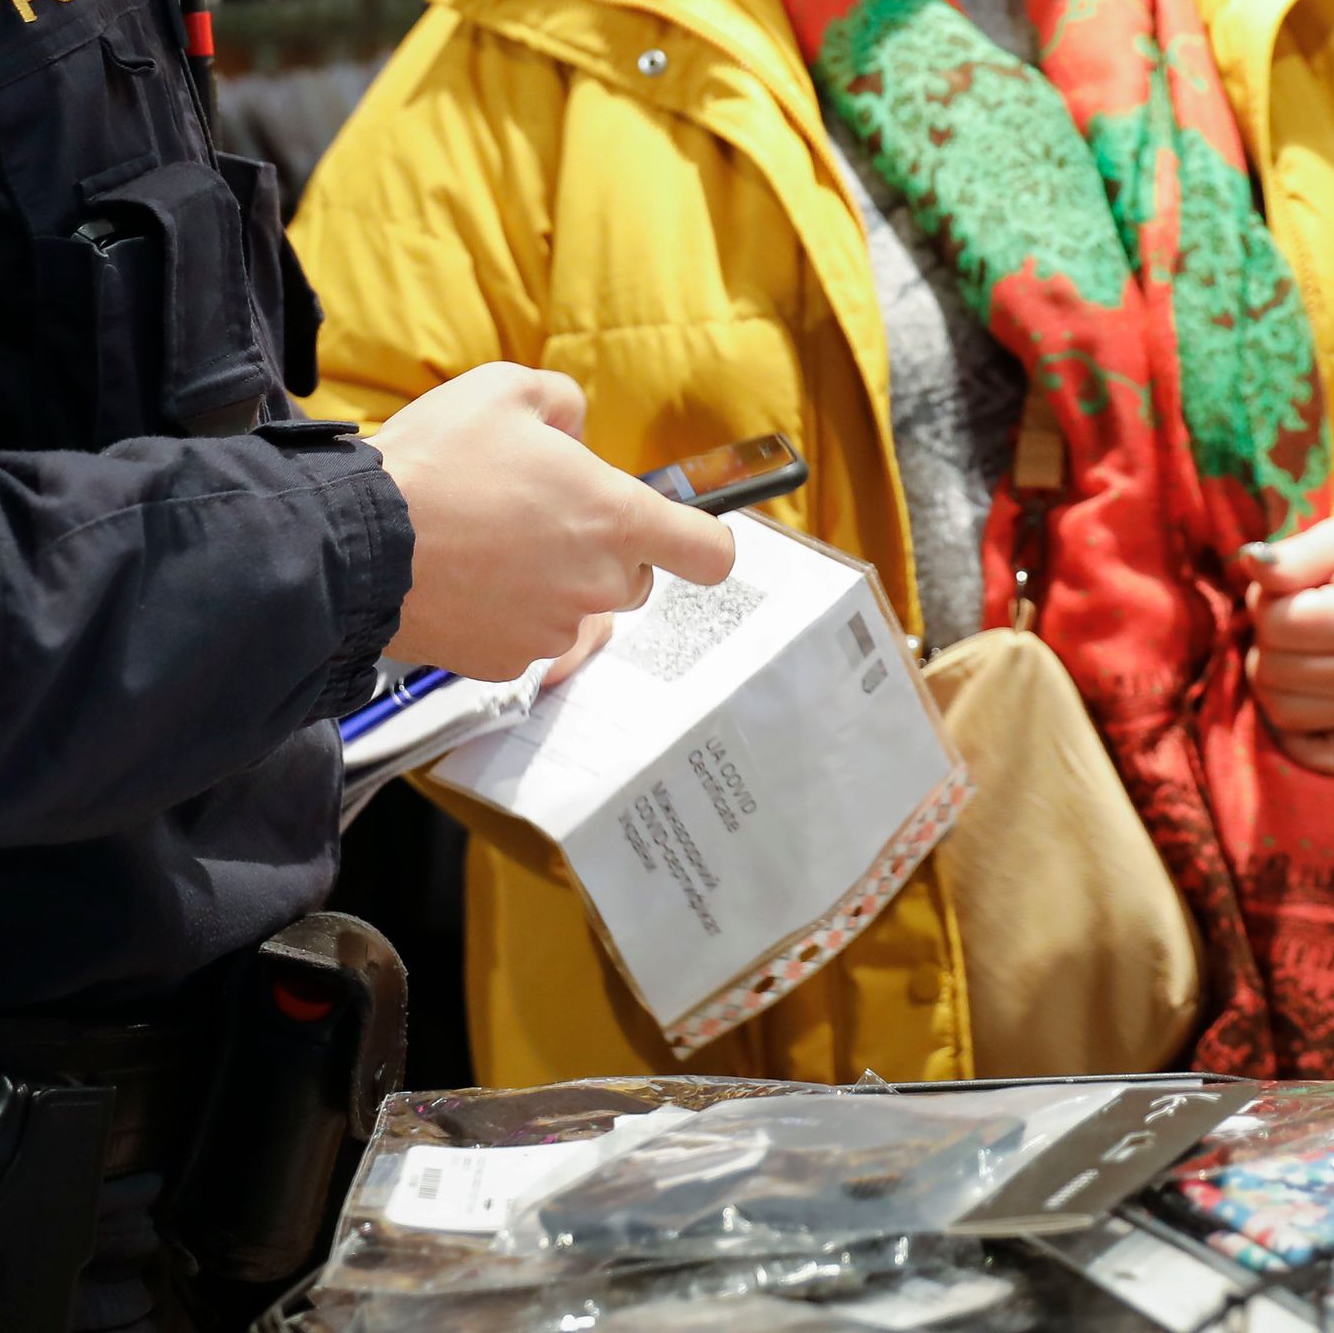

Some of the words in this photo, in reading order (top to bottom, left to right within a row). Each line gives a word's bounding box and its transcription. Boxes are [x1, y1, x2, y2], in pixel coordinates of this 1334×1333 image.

[688, 749, 740, 833] Certificate
[706, 736, 727, 764] UA
[721, 763, 757, 815] COVID
